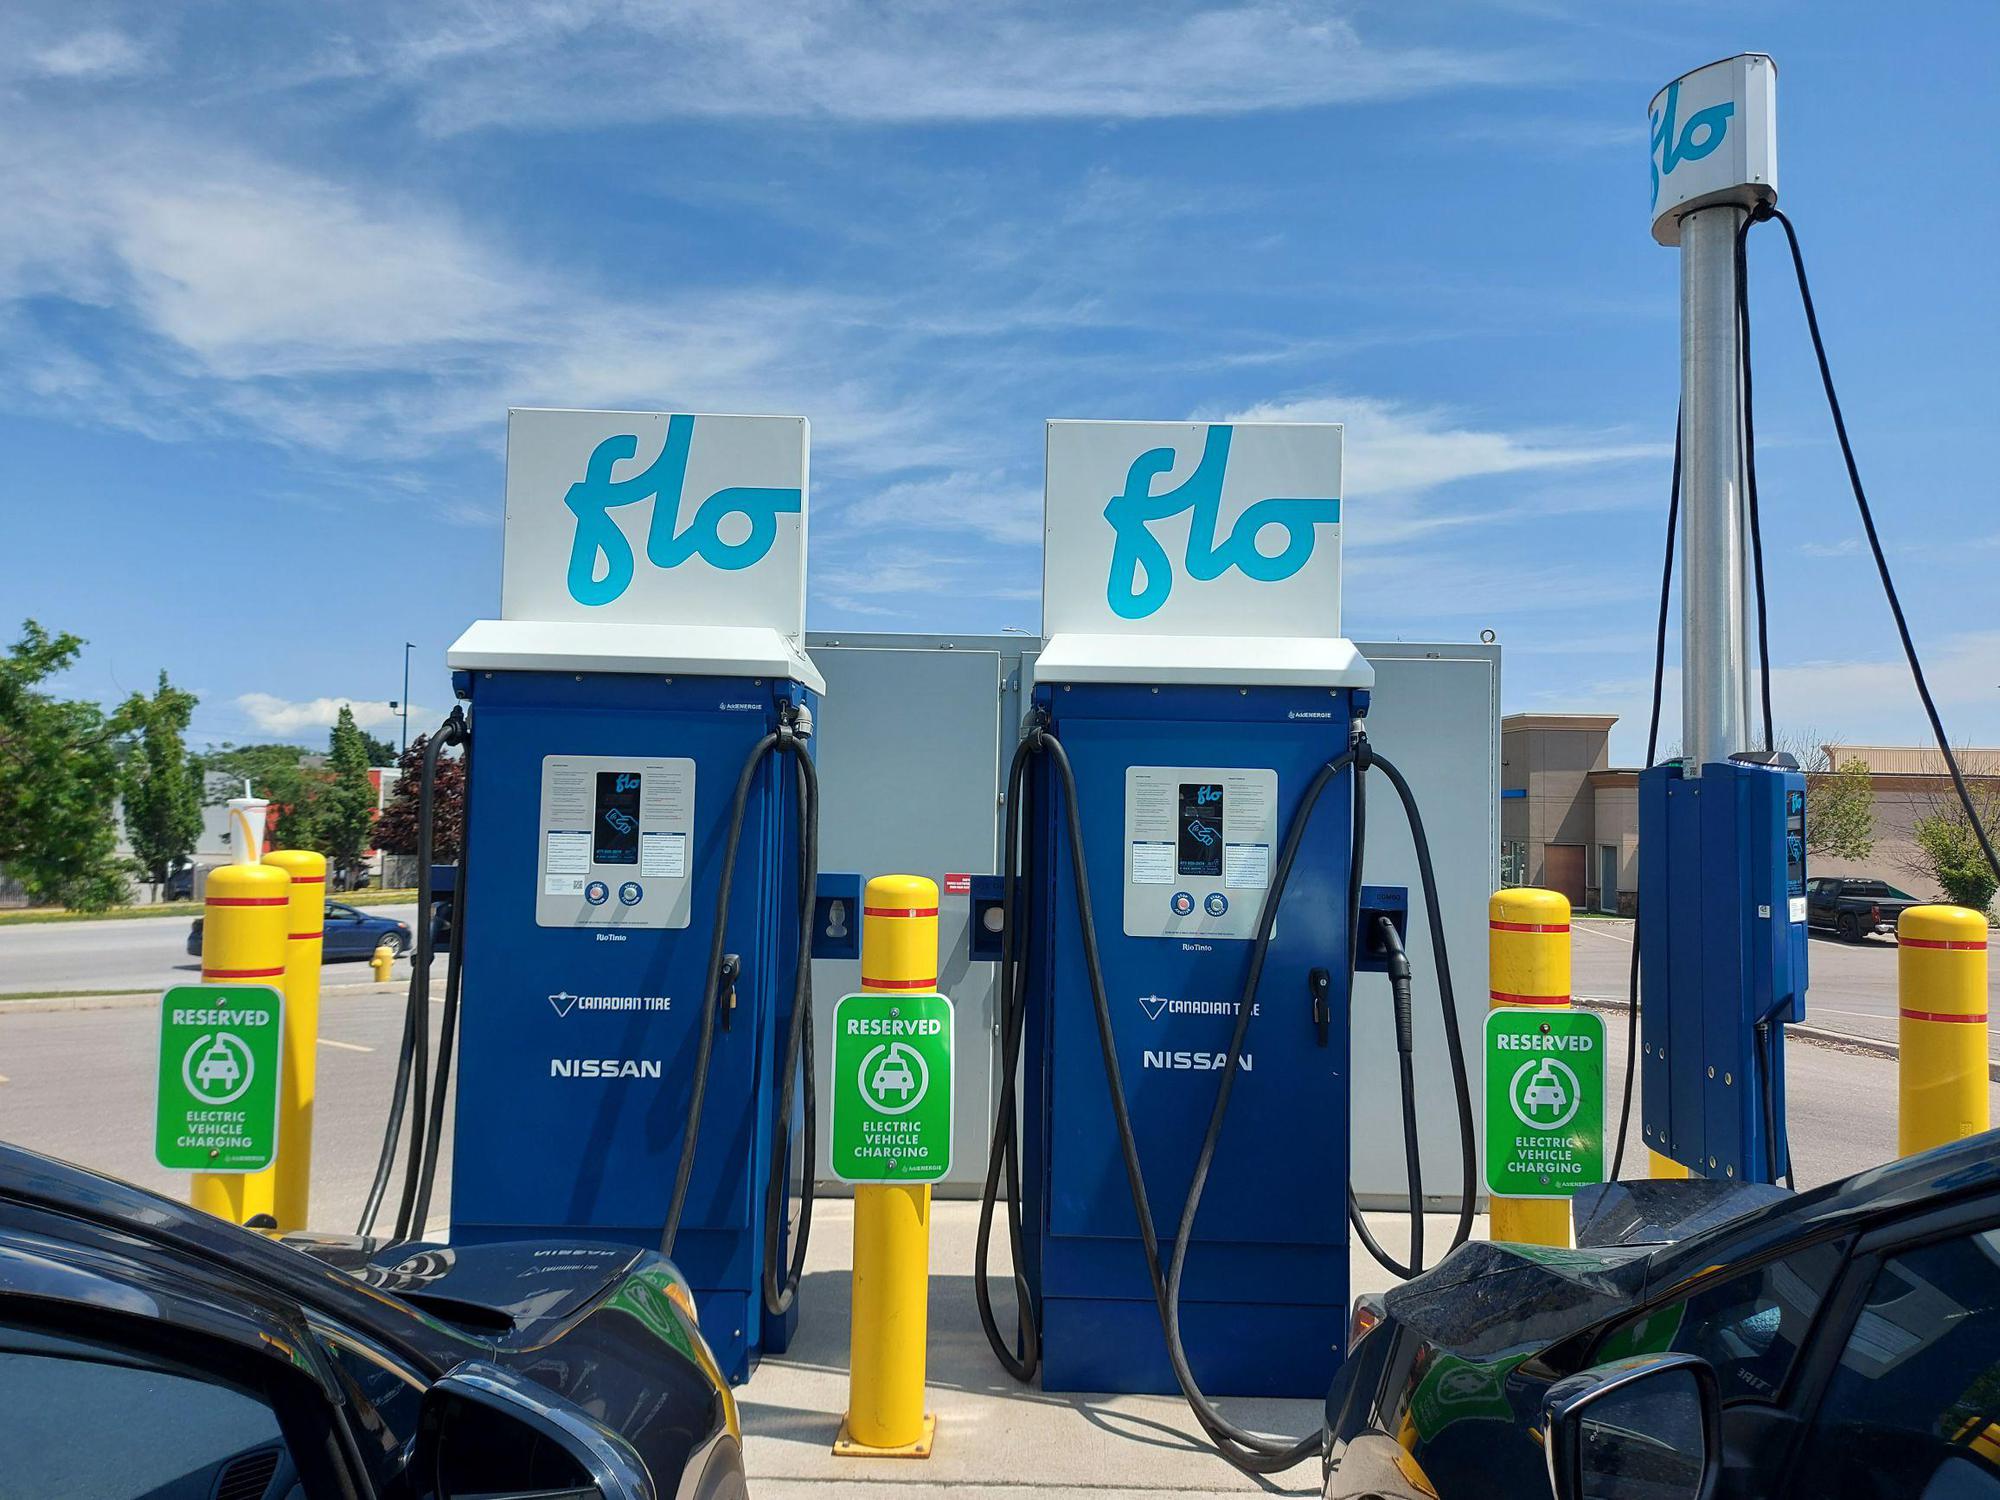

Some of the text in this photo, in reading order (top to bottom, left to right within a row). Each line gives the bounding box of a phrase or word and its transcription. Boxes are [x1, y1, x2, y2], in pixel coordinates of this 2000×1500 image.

[563, 415, 801, 607] flo
[1103, 425, 1340, 619] flo
[616, 774, 640, 793] flo
[1198, 785, 1222, 805] flo
[578, 996, 671, 1011] CANADIAN TIRE
[1168, 1000, 1260, 1016] CANADIAN TE
[172, 1009, 270, 1027] RESERVED
[847, 1019, 941, 1036] RESERVED
[1497, 1034, 1593, 1052] RESERVED
[550, 1059, 662, 1078] NISSAN
[1143, 1050, 1253, 1072] NISSAN
[186, 1111, 246, 1122] ELECTRIC
[188, 1124, 243, 1135] VEHICLE
[863, 1121, 921, 1132] ELECTRIC
[177, 1136, 253, 1148] CHARGING
[865, 1134, 919, 1145] VEHICLE
[1515, 1137, 1574, 1148] ELECTRIC
[854, 1147, 929, 1158] CHARGING
[1518, 1149, 1572, 1161] VEHICLE
[1507, 1162, 1582, 1174] CHARGING
